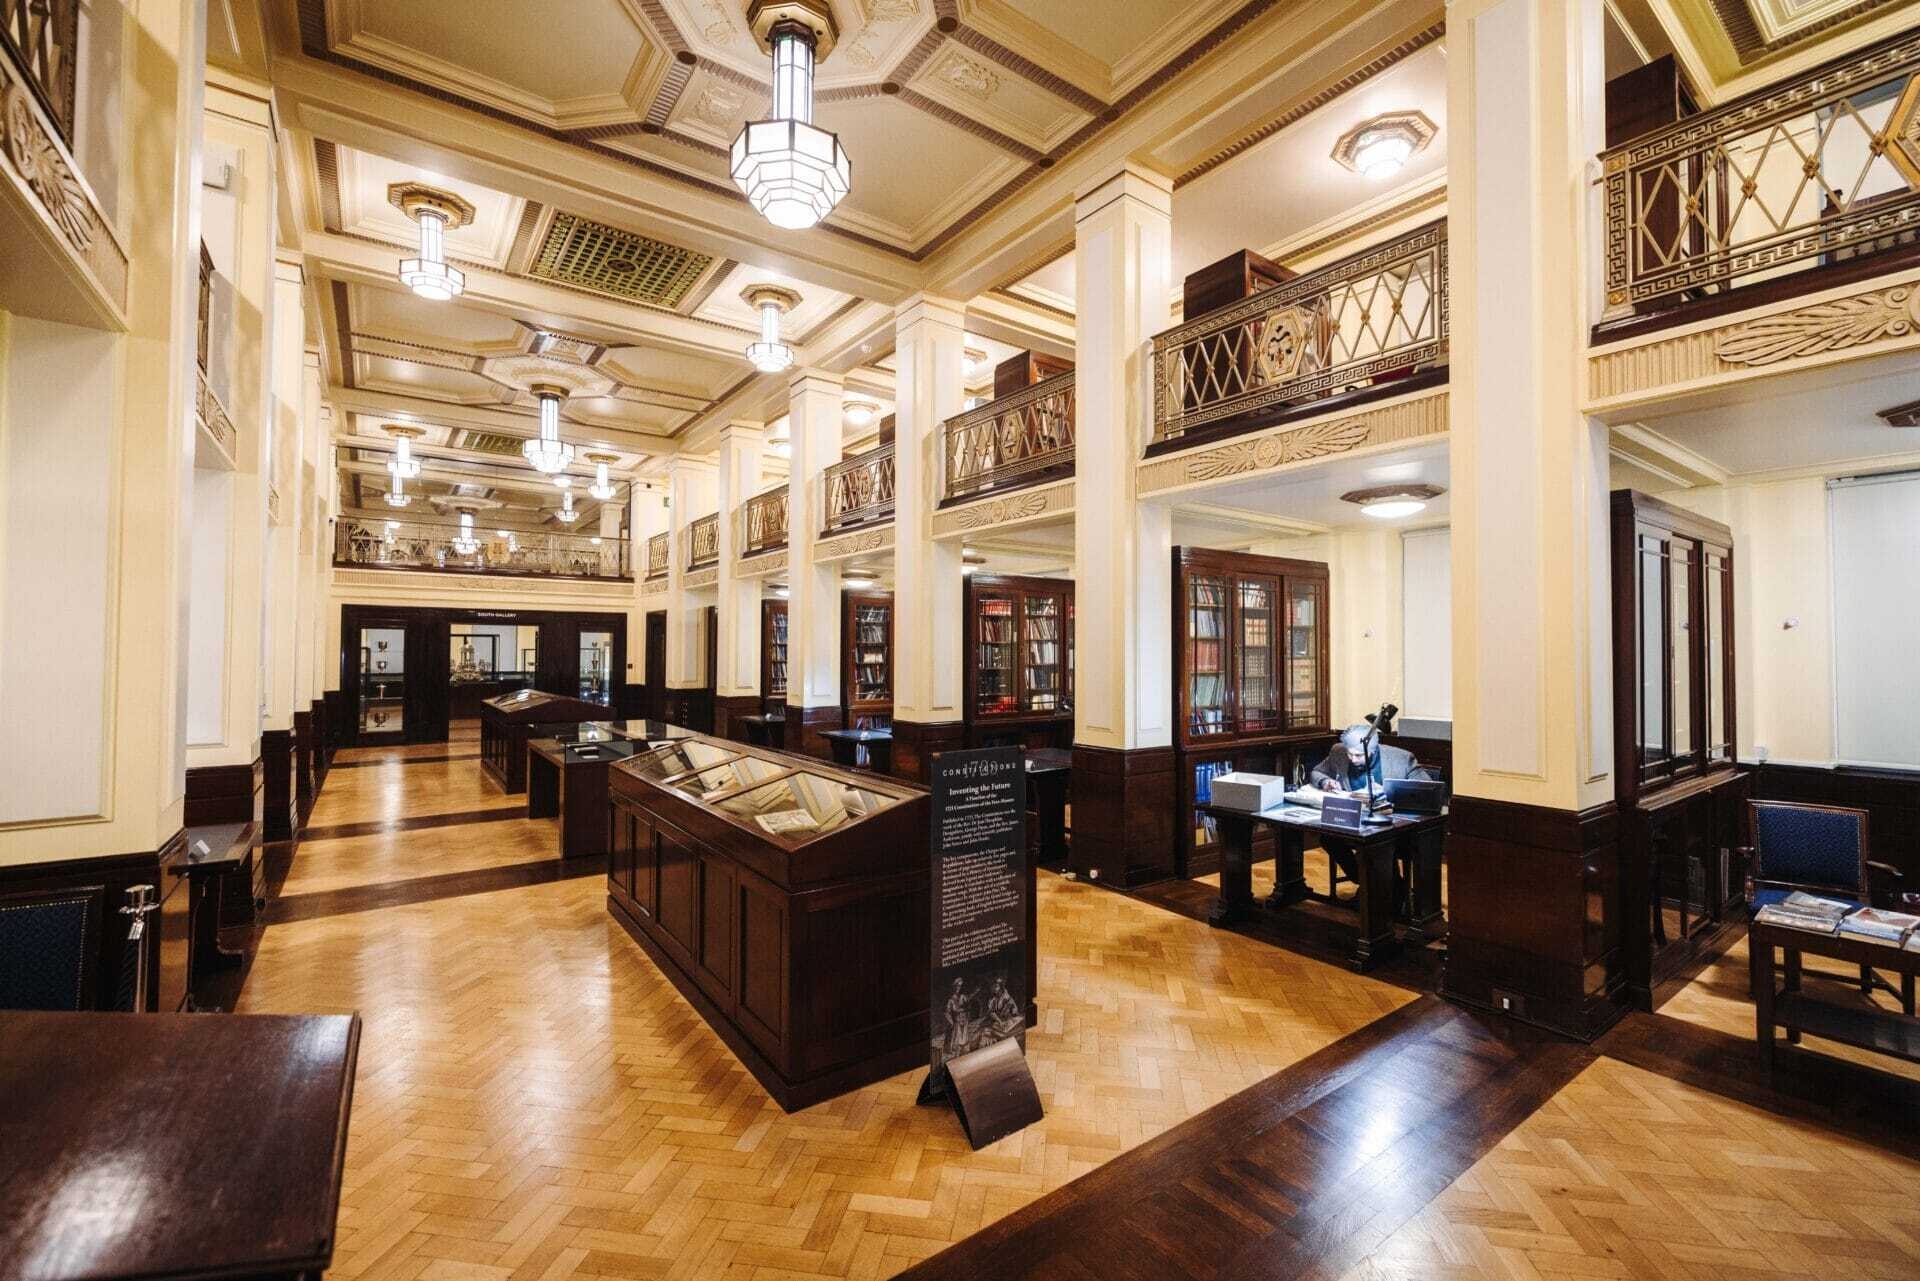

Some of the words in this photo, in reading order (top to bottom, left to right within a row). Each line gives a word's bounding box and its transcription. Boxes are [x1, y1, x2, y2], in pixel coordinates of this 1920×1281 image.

[949, 785, 979, 797] Inventing
[980, 784, 991, 792] the
[991, 783, 1011, 791] Future
